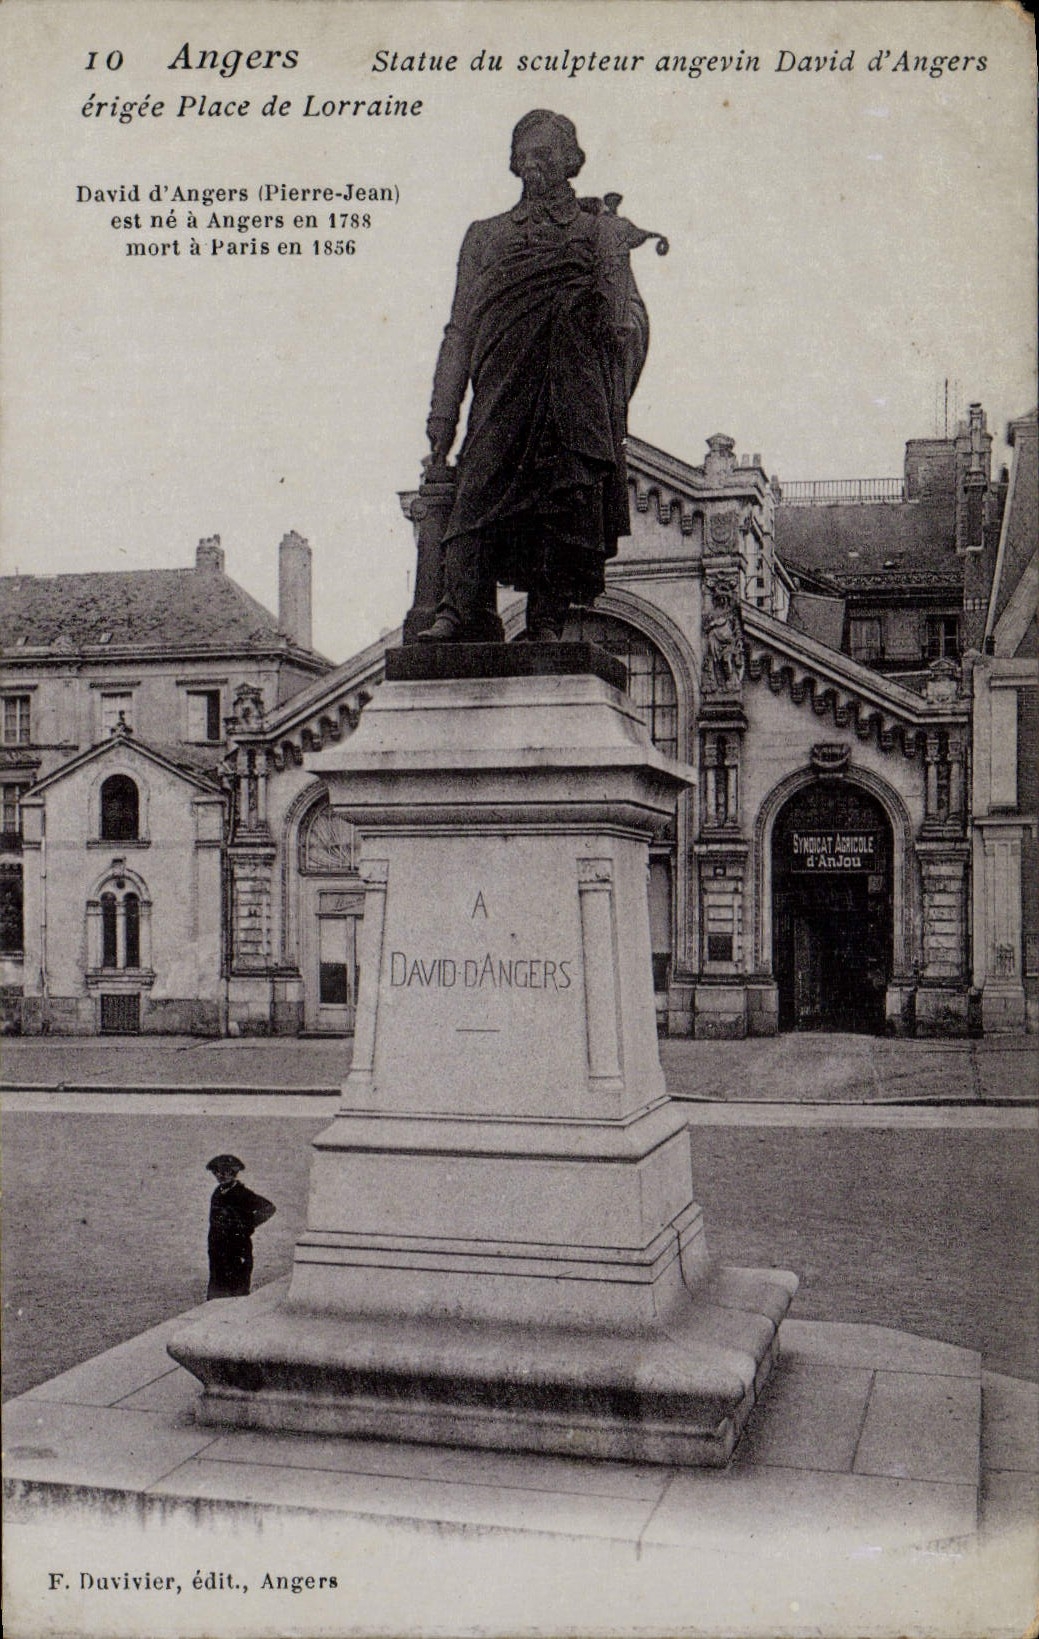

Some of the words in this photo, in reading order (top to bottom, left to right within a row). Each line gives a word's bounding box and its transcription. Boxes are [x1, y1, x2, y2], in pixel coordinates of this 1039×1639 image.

[793, 833, 833, 854] SYNDICAT
[834, 833, 874, 854] AGRICOLE
[471, 890, 488, 919] A
[390, 951, 457, 988] DAVID
